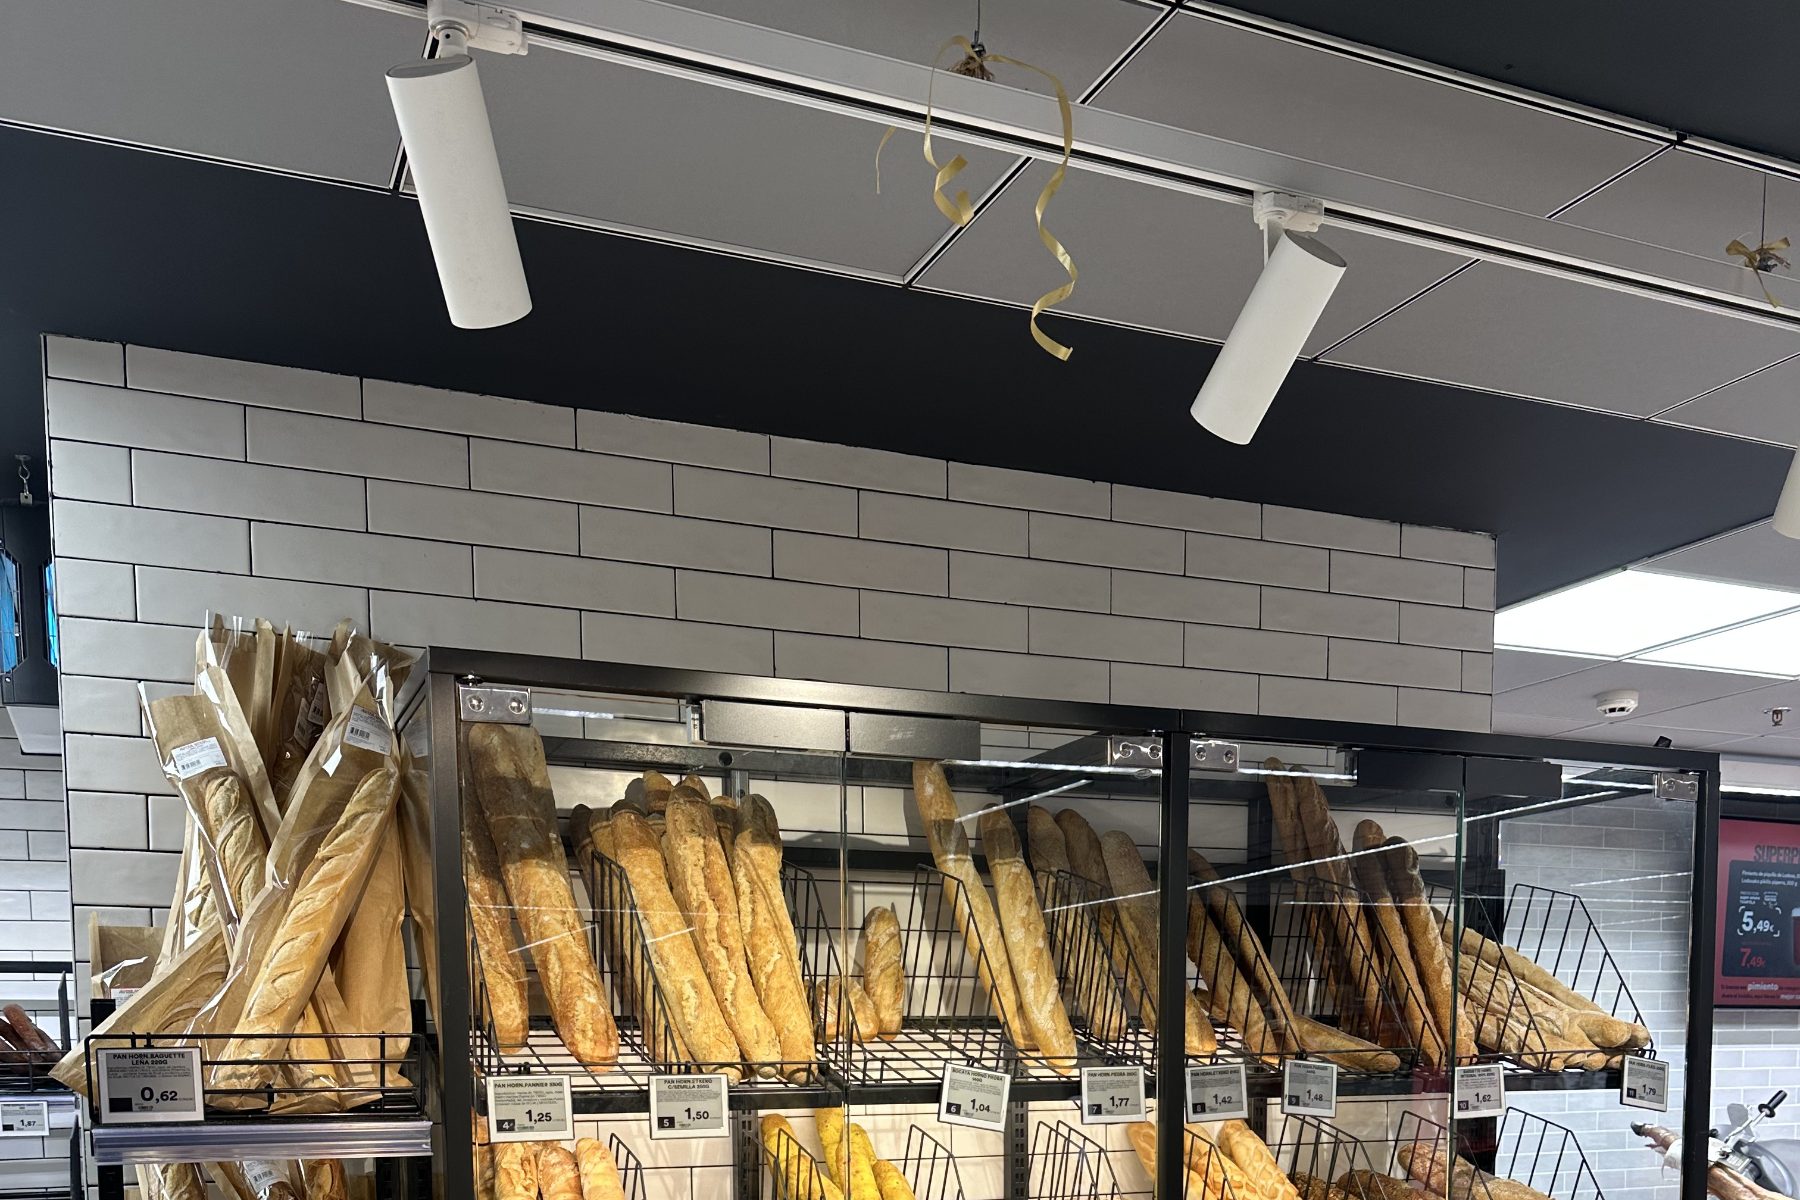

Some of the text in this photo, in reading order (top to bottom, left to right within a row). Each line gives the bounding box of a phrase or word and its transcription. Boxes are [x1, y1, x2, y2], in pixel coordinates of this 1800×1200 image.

[1742, 911, 1774, 933] 5,49€
[141, 1087, 178, 1103] 0,62
[1306, 1089, 1323, 1102] 1,48
[1642, 1084, 1657, 1096] 1,79
[1110, 1096, 1130, 1108] 1,77
[1213, 1094, 1233, 1107] 1,42
[1475, 1092, 1492, 1104] 1,62
[951, 1105, 957, 1113] 6
[970, 1098, 990, 1112] 1,04
[525, 1109, 552, 1125] 1,25
[684, 1107, 709, 1121] 1,50
[20, 1119, 36, 1127] 1,87
[502, 1121, 510, 1130] 4
[663, 1119, 670, 1127] 5
